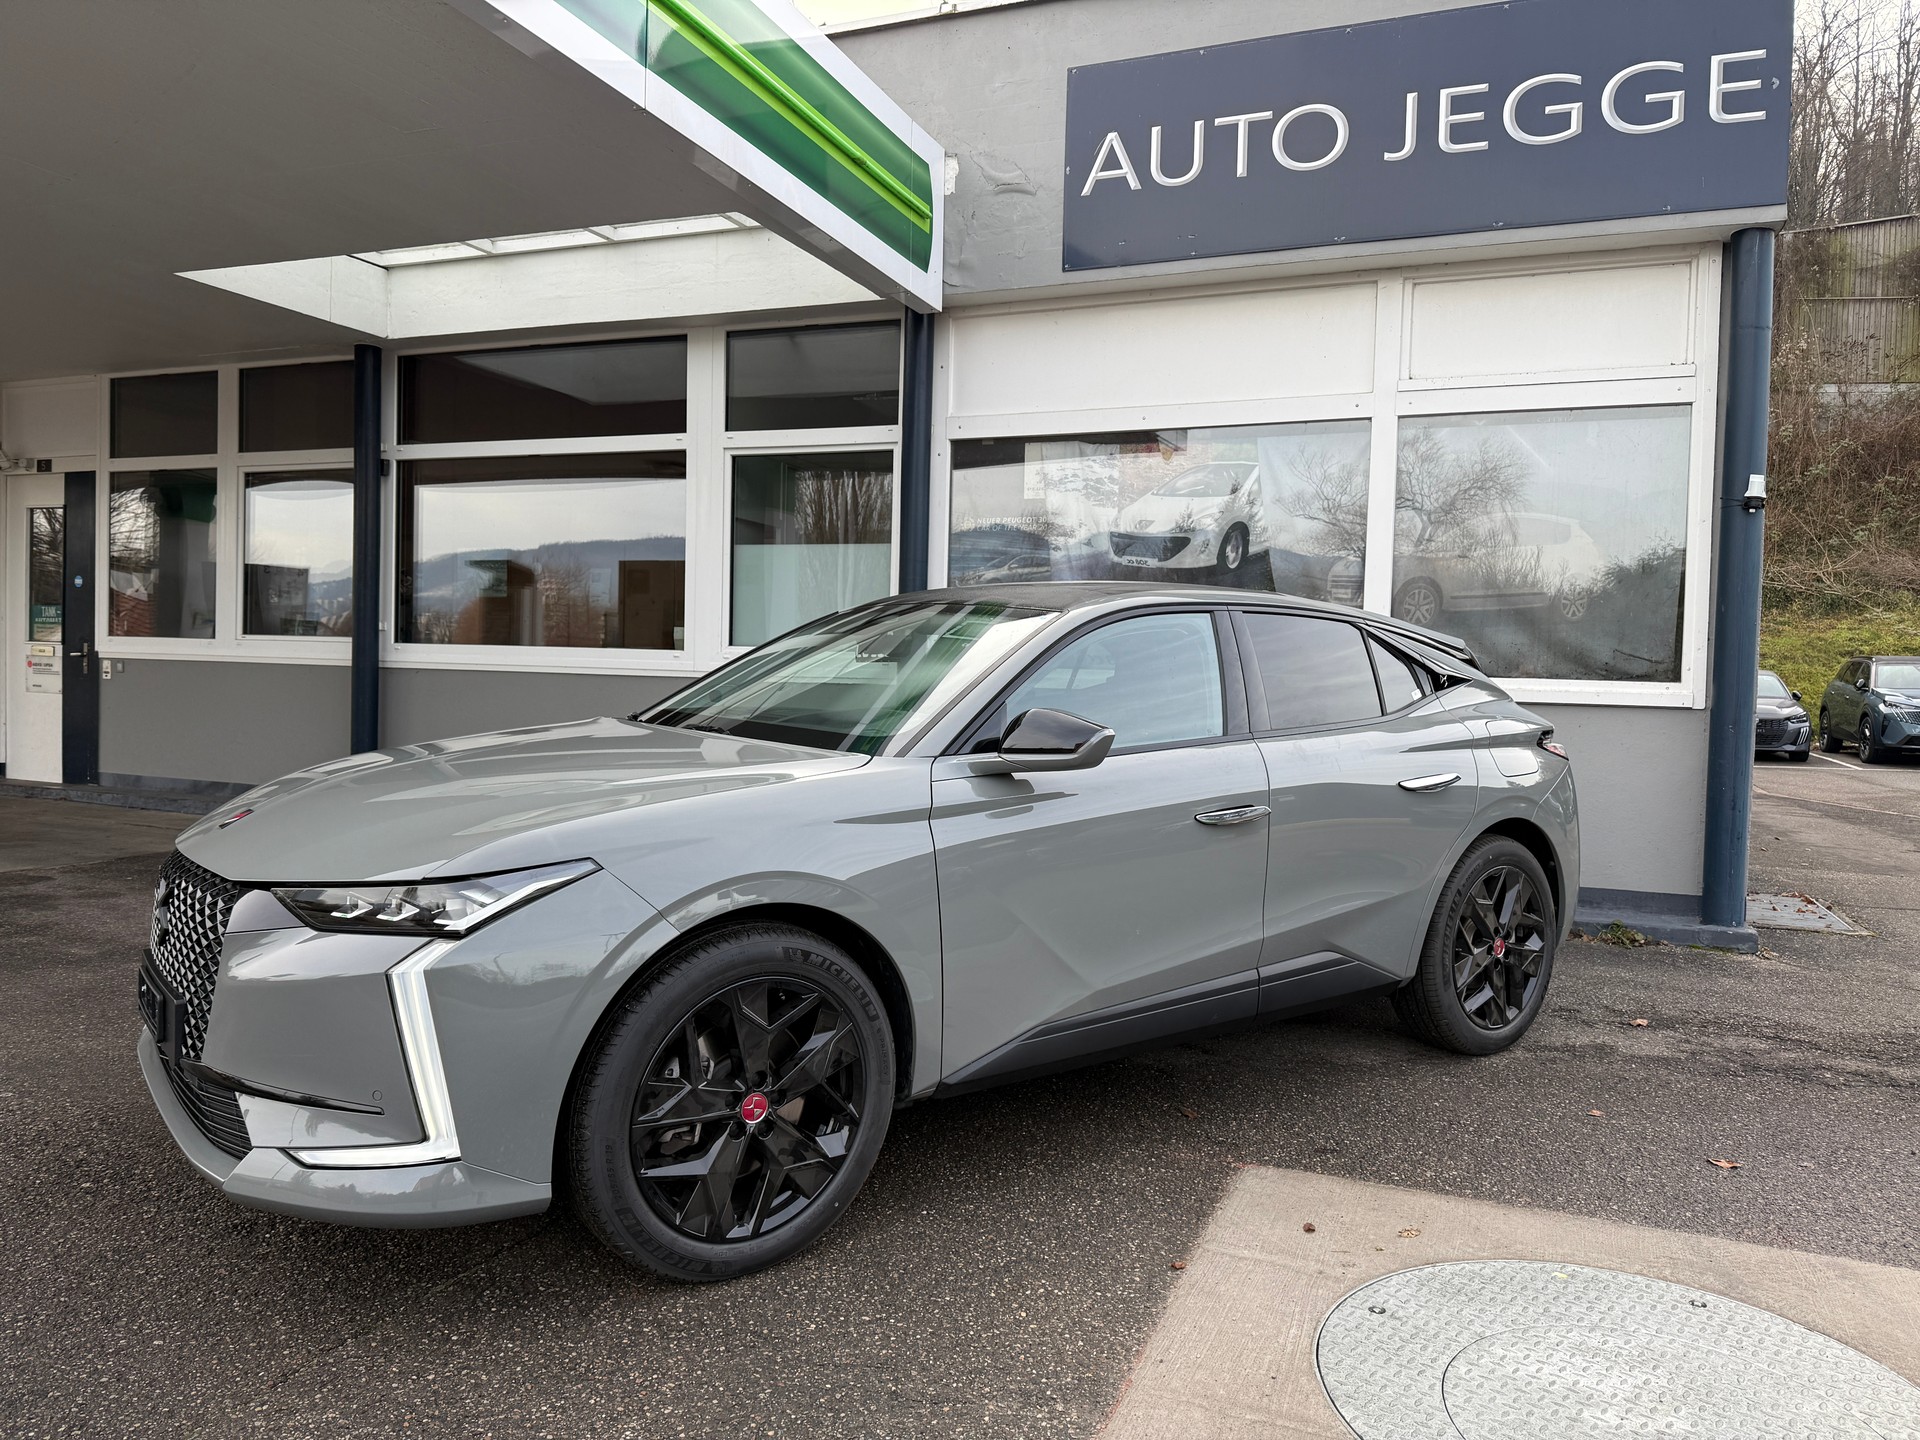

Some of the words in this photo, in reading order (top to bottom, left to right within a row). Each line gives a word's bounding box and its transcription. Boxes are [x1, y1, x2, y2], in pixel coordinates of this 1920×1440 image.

[1080, 103, 1350, 196] AUTO
[1384, 48, 1767, 161] JEGGE
[977, 517, 1001, 525] NEUER
[1002, 516, 1037, 524] PEUGEOT
[977, 524, 991, 532] CAR
[992, 524, 1003, 532] OF
[806, 953, 878, 1018] MICHELIN
